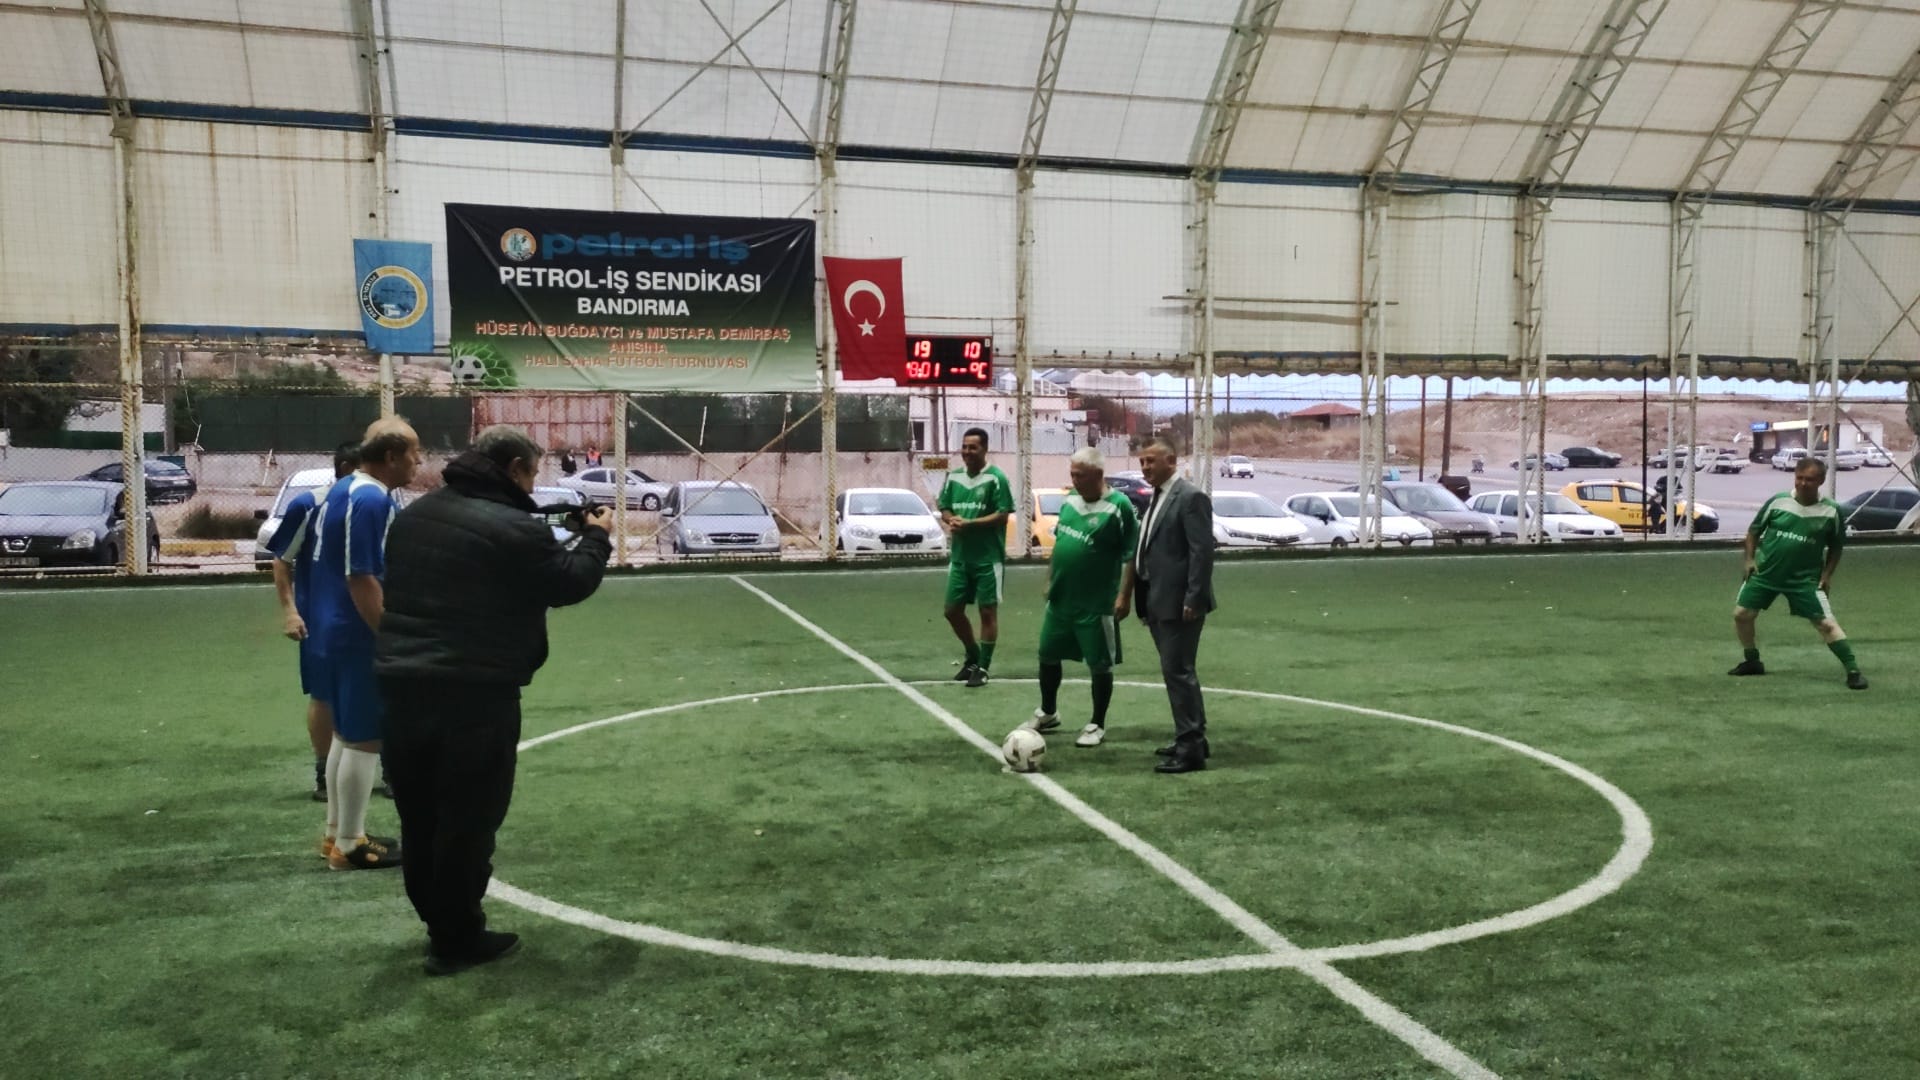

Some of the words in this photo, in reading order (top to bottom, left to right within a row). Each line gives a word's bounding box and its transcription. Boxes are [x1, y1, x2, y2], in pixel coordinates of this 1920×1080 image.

[499, 266, 629, 293] PETROL-İŞ
[636, 269, 762, 292] SENDİKASI
[577, 297, 690, 316] BANDIRMA
[475, 320, 543, 337] HÜSEYİN
[628, 330, 643, 338] ve
[647, 327, 716, 340] MUSTAFA
[719, 326, 791, 343] DEMİRBAŞ
[914, 340, 931, 358] 19
[964, 341, 981, 359] 10
[525, 354, 559, 367] HALI
[564, 356, 601, 368] SAHA
[607, 356, 664, 368] FUTBOL
[668, 357, 748, 369] TURNUVASI
